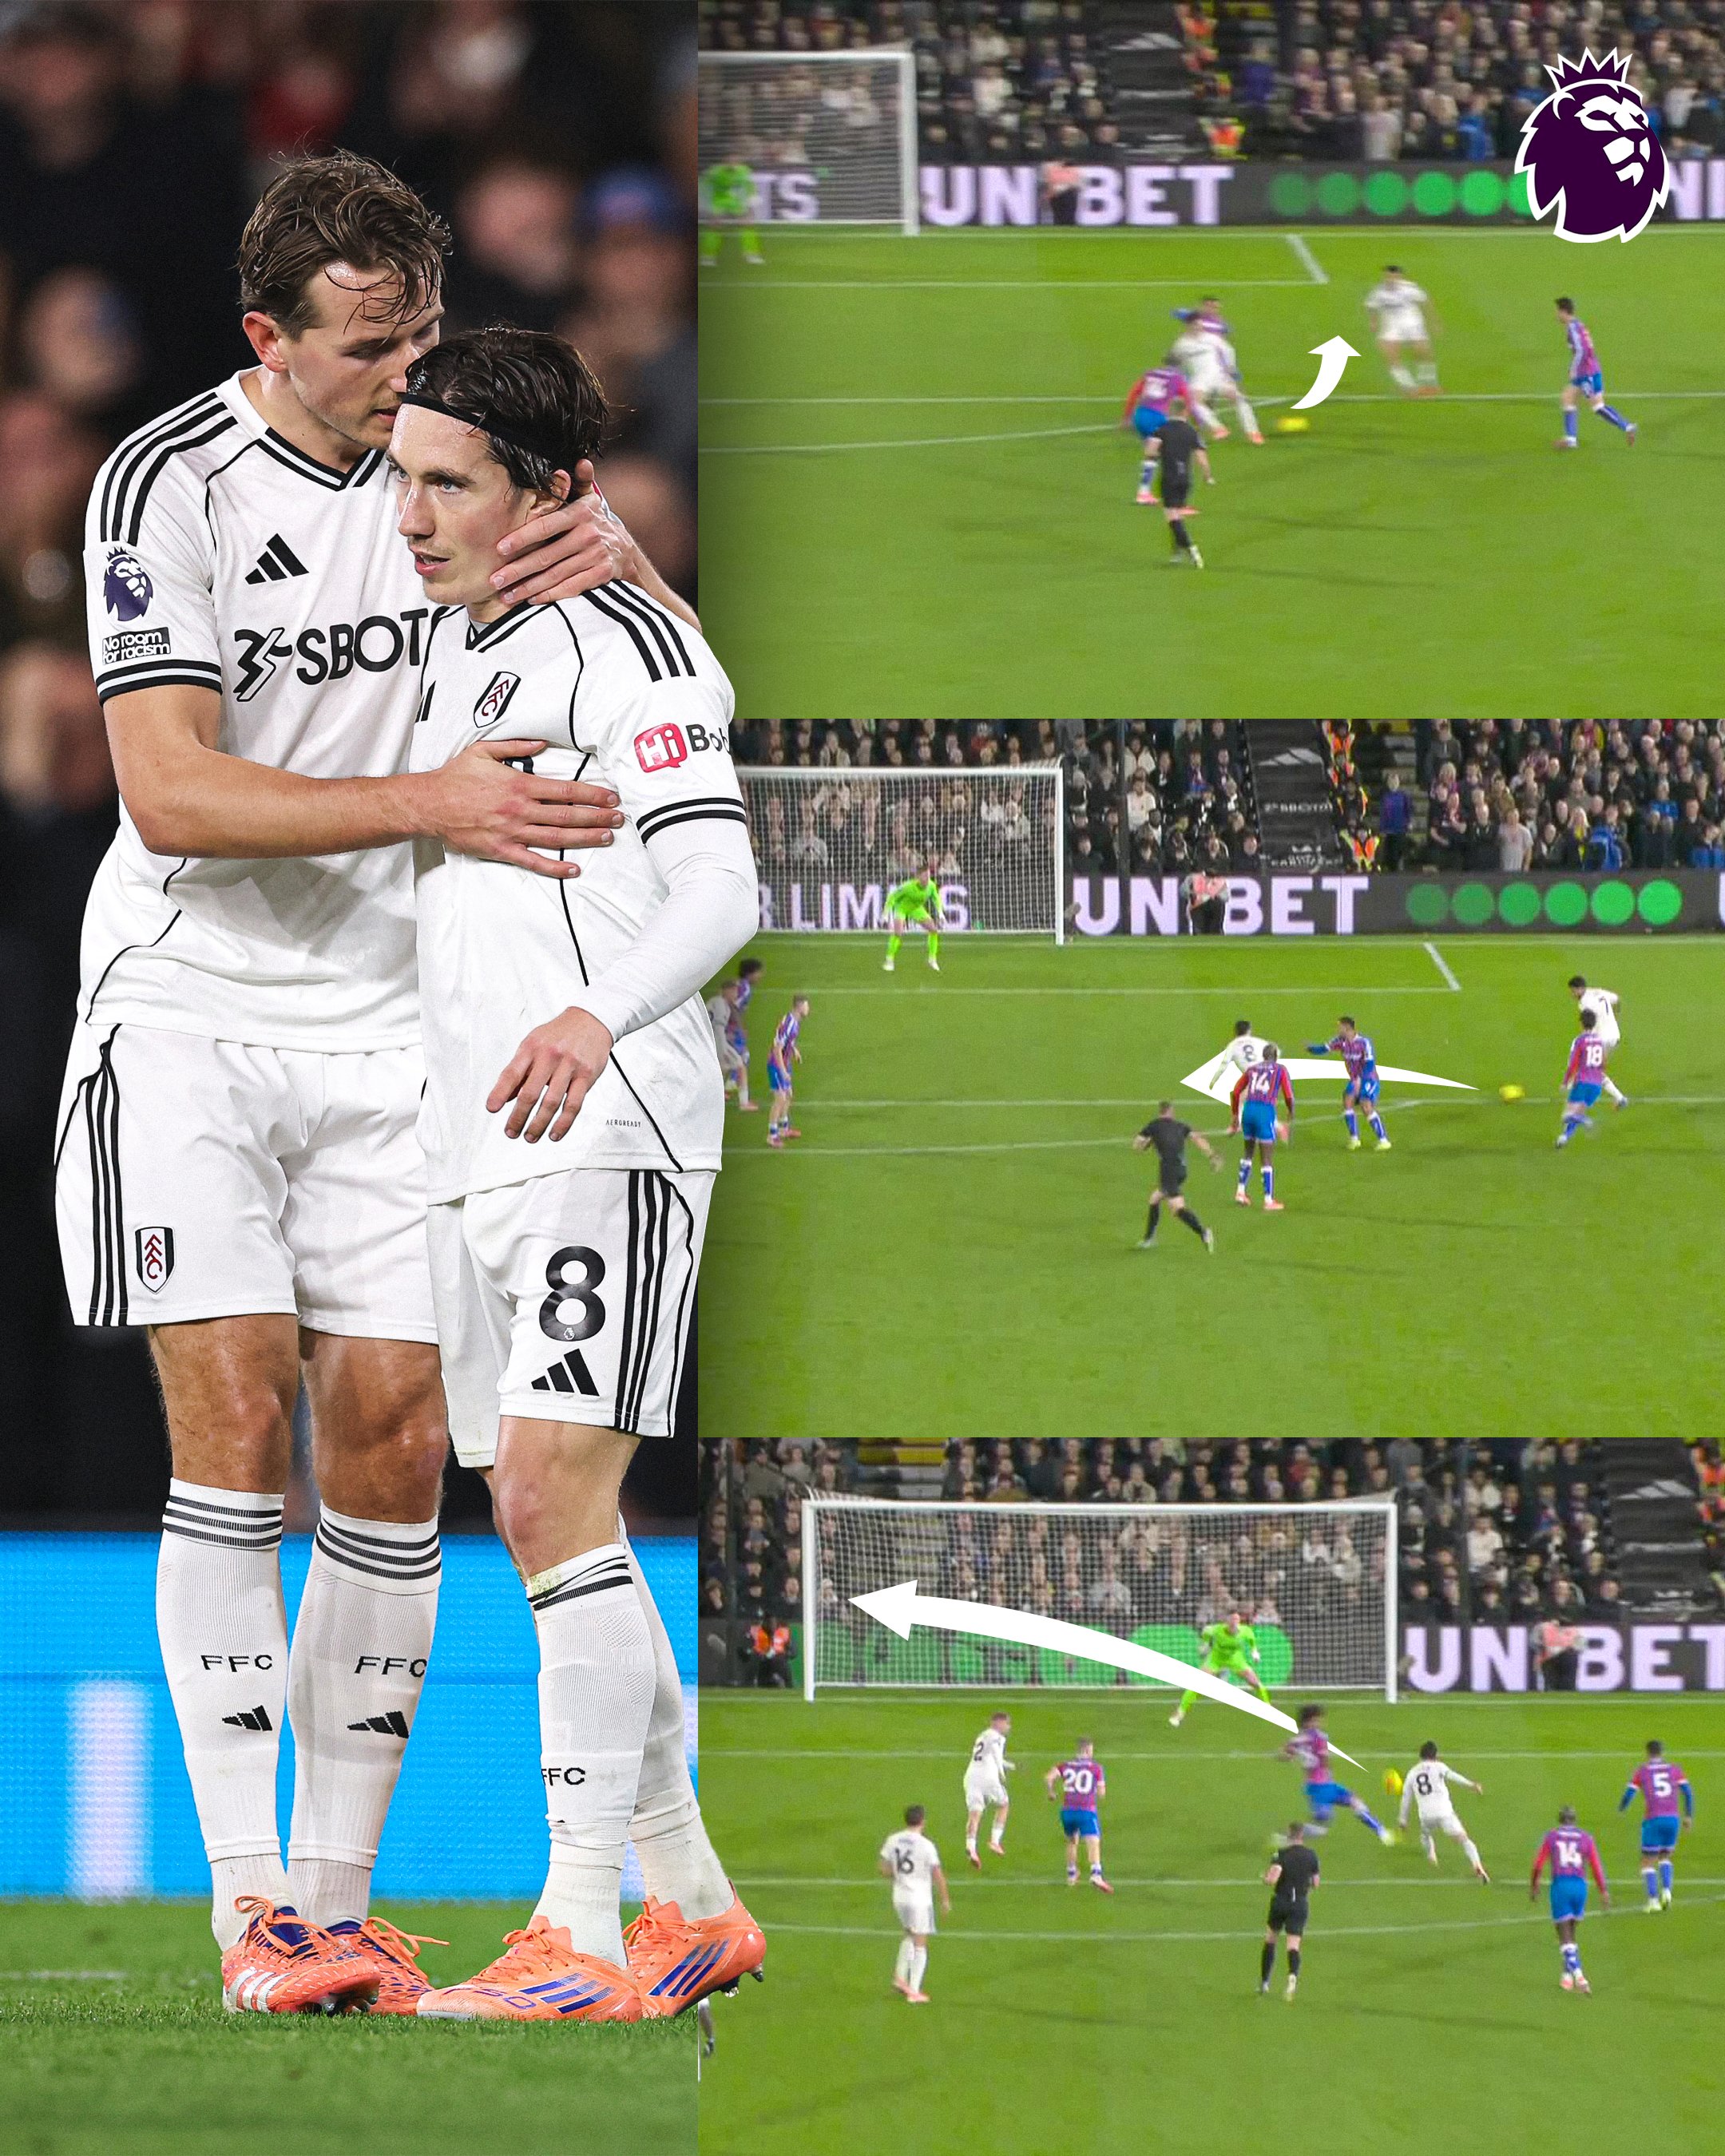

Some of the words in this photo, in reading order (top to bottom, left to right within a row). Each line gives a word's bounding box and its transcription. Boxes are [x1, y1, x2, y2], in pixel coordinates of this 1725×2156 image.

[920, 164, 1235, 226] UNBET
[102, 648, 120, 665] for
[121, 643, 171, 661] racism
[103, 636, 120, 652] No
[121, 632, 163, 648] room
[296, 606, 450, 685] SBOT
[1073, 876, 1370, 936] UNBET
[1585, 1044, 1602, 1067] 18
[1251, 1072, 1271, 1093] 14
[144, 1234, 163, 1279] FFC
[539, 1245, 606, 1342] 8
[200, 1655, 272, 1672] FFC
[355, 1655, 427, 1678] FFC
[1406, 1625, 1725, 1691] UNBET
[1063, 1768, 1093, 1794] 20
[1417, 1773, 1432, 1795] 8
[1653, 1772, 1672, 1797] 5
[895, 1848, 914, 1874] 16
